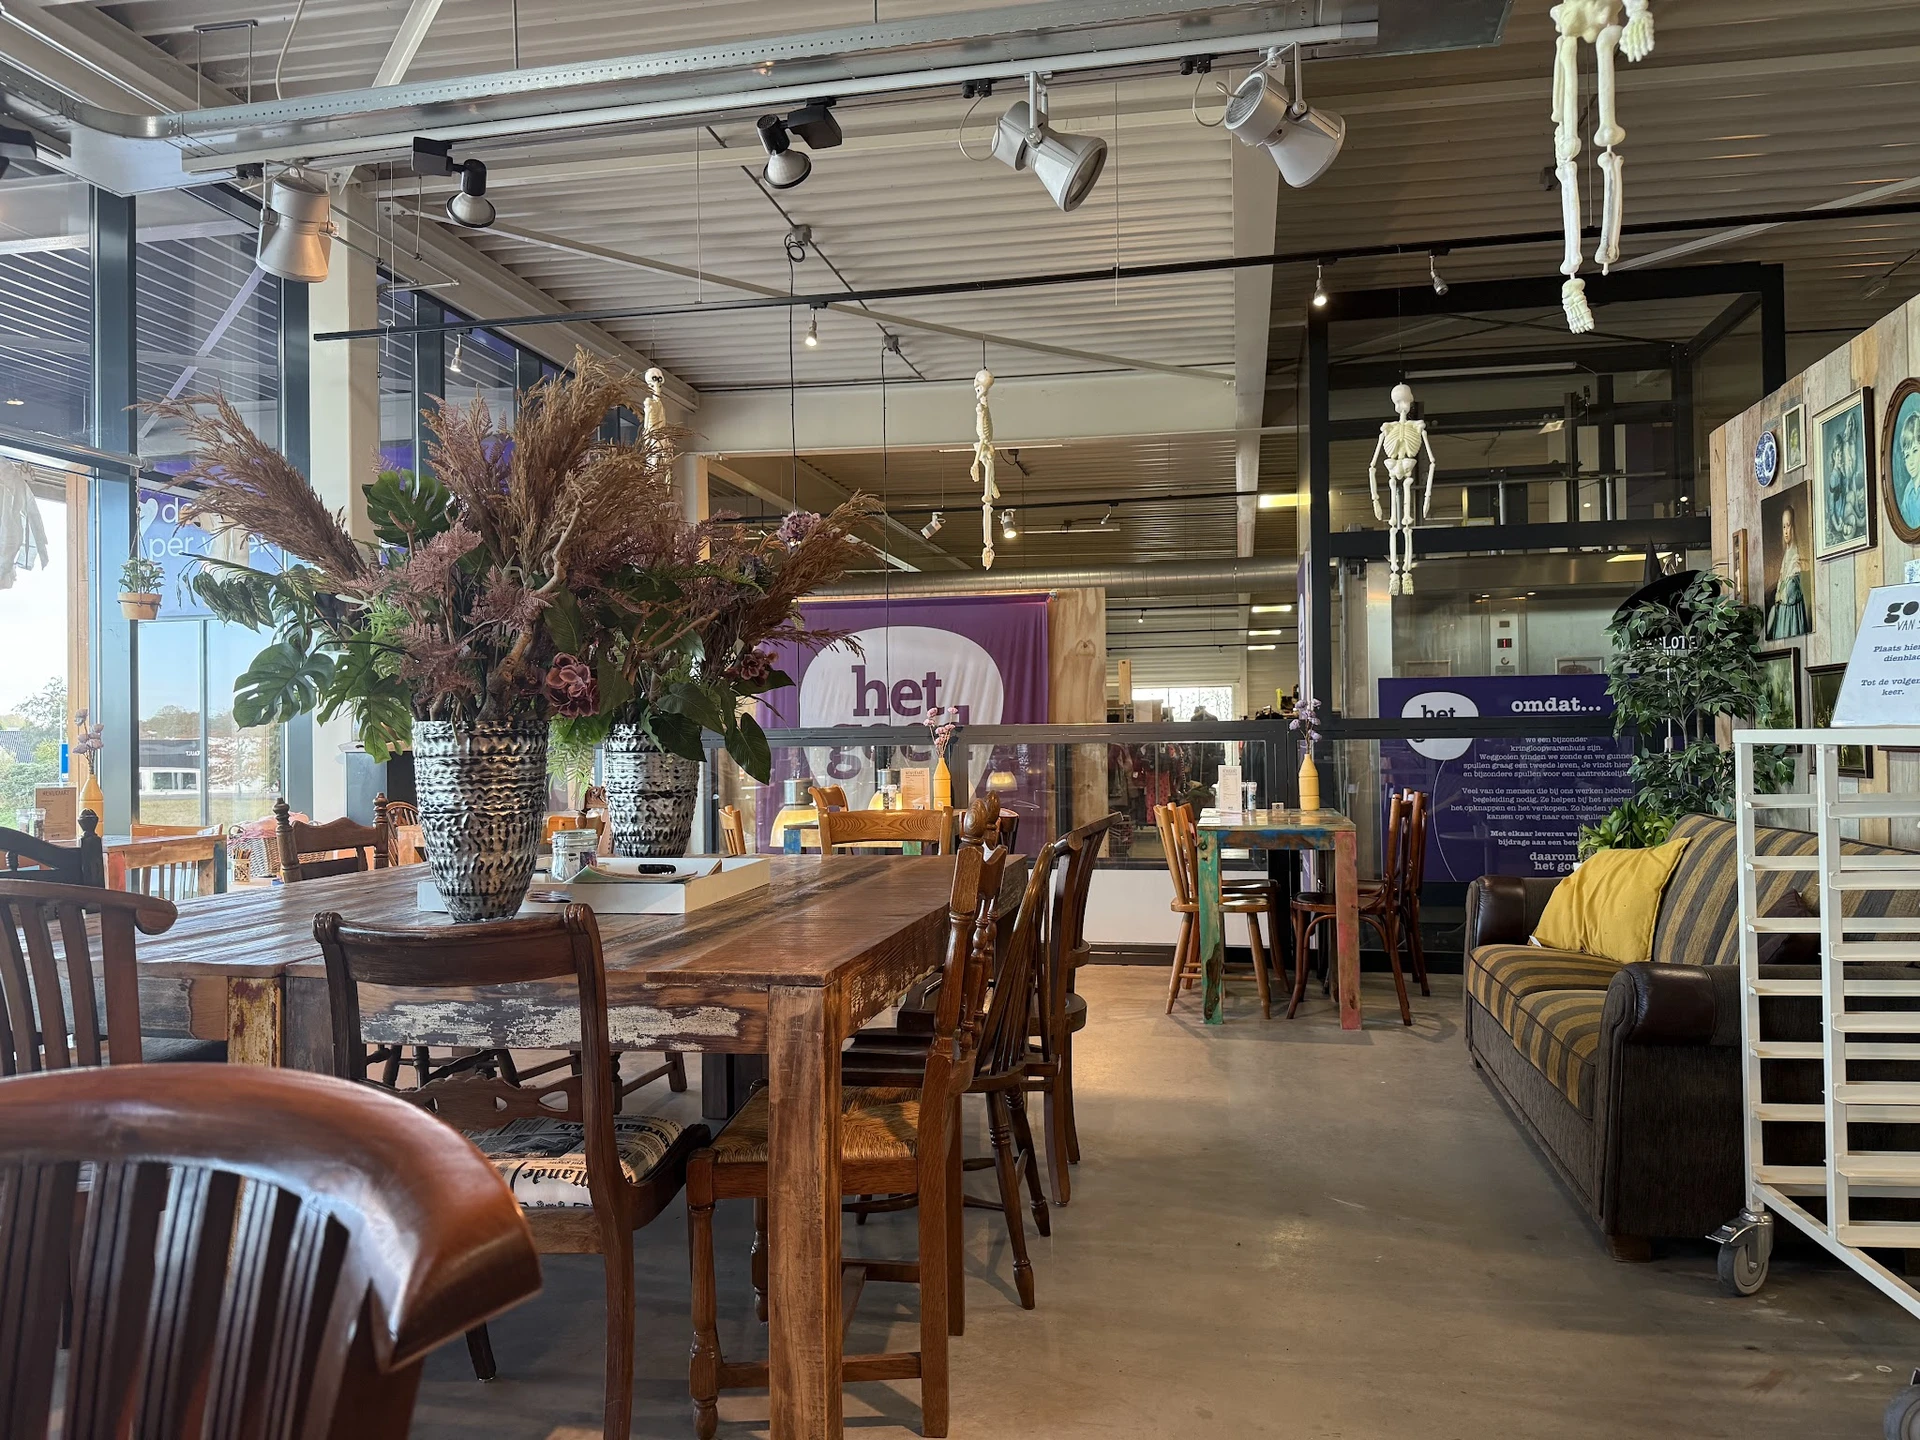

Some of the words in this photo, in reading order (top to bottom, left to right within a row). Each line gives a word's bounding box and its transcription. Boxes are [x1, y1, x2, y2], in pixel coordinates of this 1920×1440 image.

[149, 536, 194, 561] per
[1884, 600, 1920, 624] go
[1897, 620, 1915, 631] VAN
[1873, 644, 1902, 653] Plaats
[1861, 678, 1877, 687] Tot
[1878, 678, 1889, 686] de
[852, 665, 945, 717] het
[1881, 688, 1905, 697] keer.
[1511, 697, 1602, 713] omdat...
[1421, 705, 1456, 718] het
[1552, 737, 1588, 745] bijzonder
[1510, 745, 1586, 753] kringloopwarenhuis
[1587, 745, 1603, 753] zijn.
[1463, 762, 1491, 770] spullen
[1549, 787, 1559, 795] bij
[1551, 796, 1576, 804] helpen
[1577, 796, 1587, 804] bij
[1531, 804, 1569, 812] verkopen.
[1498, 839, 1530, 847] bijdrage
[1529, 852, 1577, 861] daarom
[1534, 861, 1555, 871] het
[1556, 862, 1575, 873] go
